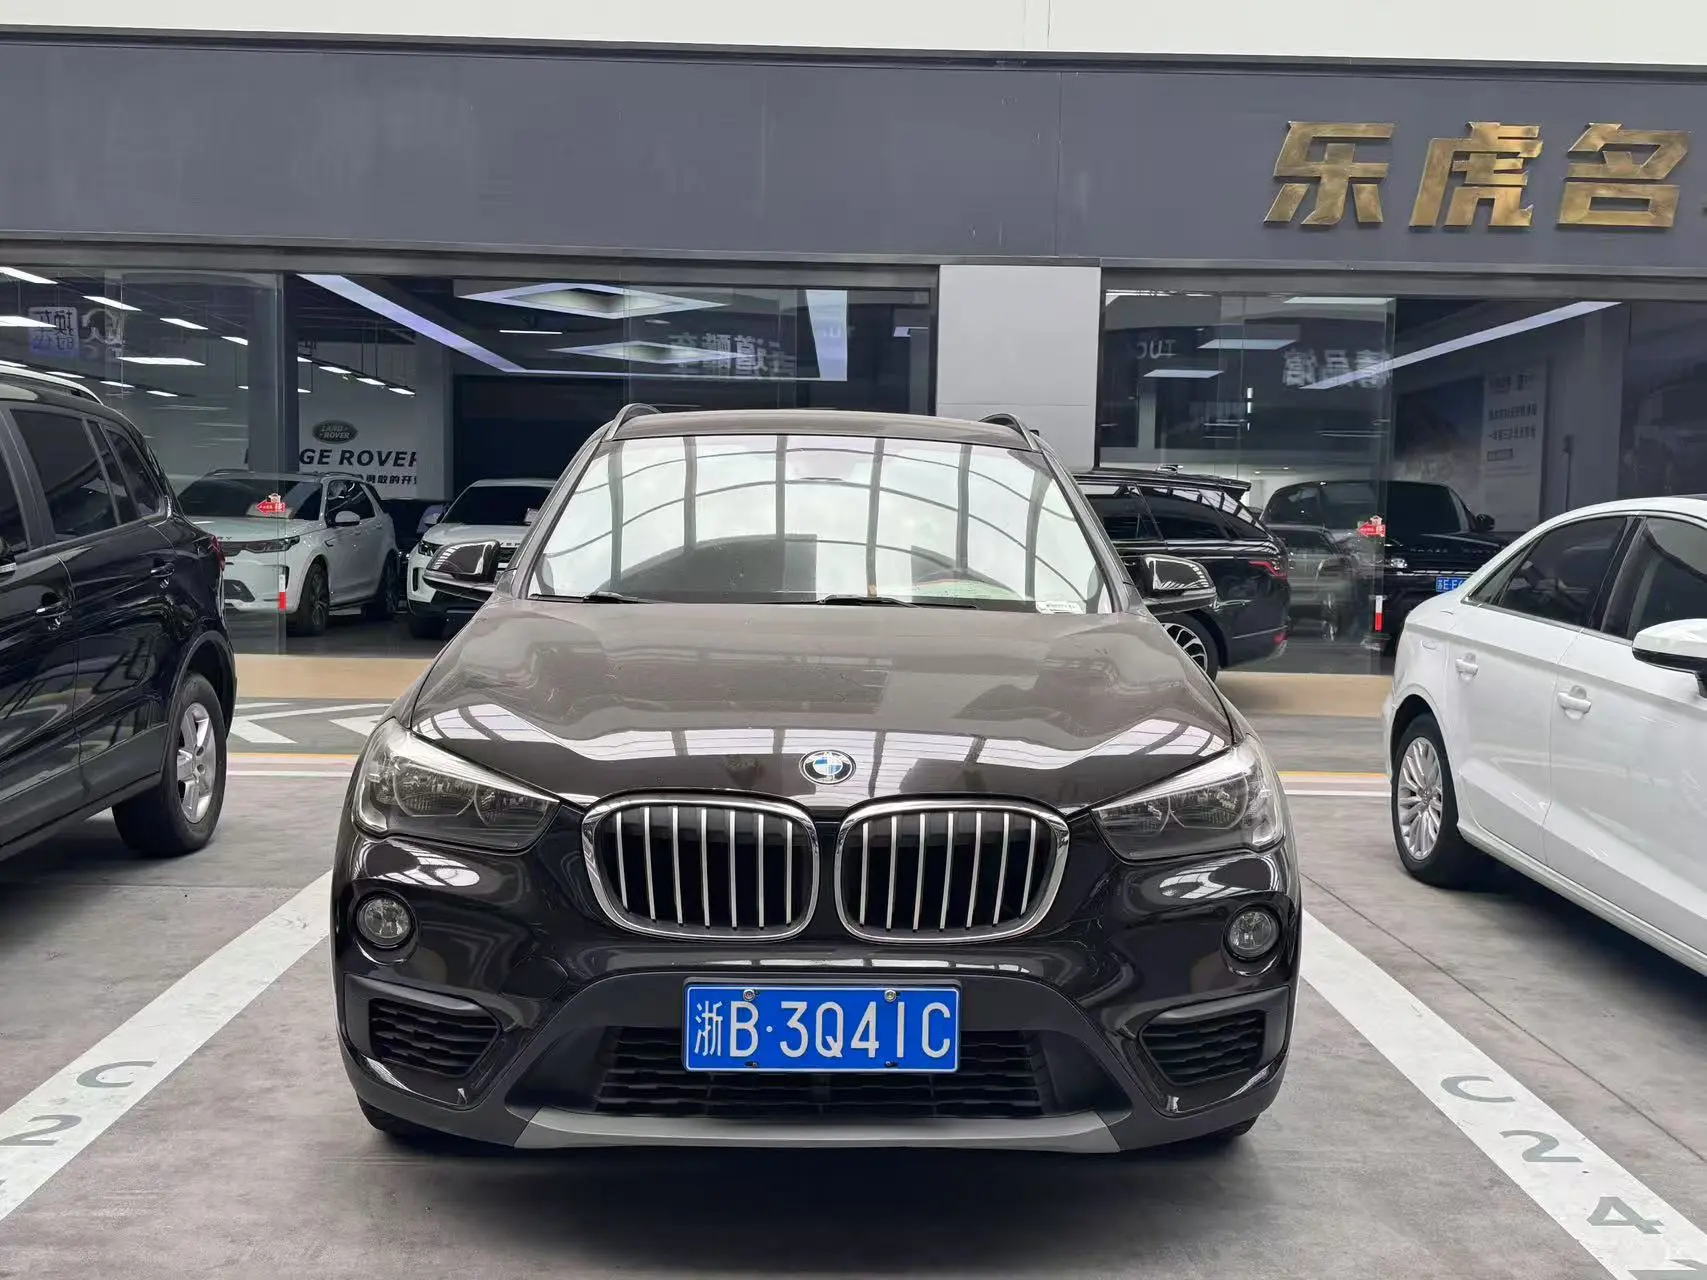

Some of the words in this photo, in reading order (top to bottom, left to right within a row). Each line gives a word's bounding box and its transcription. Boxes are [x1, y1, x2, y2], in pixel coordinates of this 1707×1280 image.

[1264, 120, 1690, 228] 乐虎名
[299, 448, 332, 465] GE
[365, 474, 416, 485] 勇敢的开
[694, 1000, 951, 1058] 浙B·3Q41C
